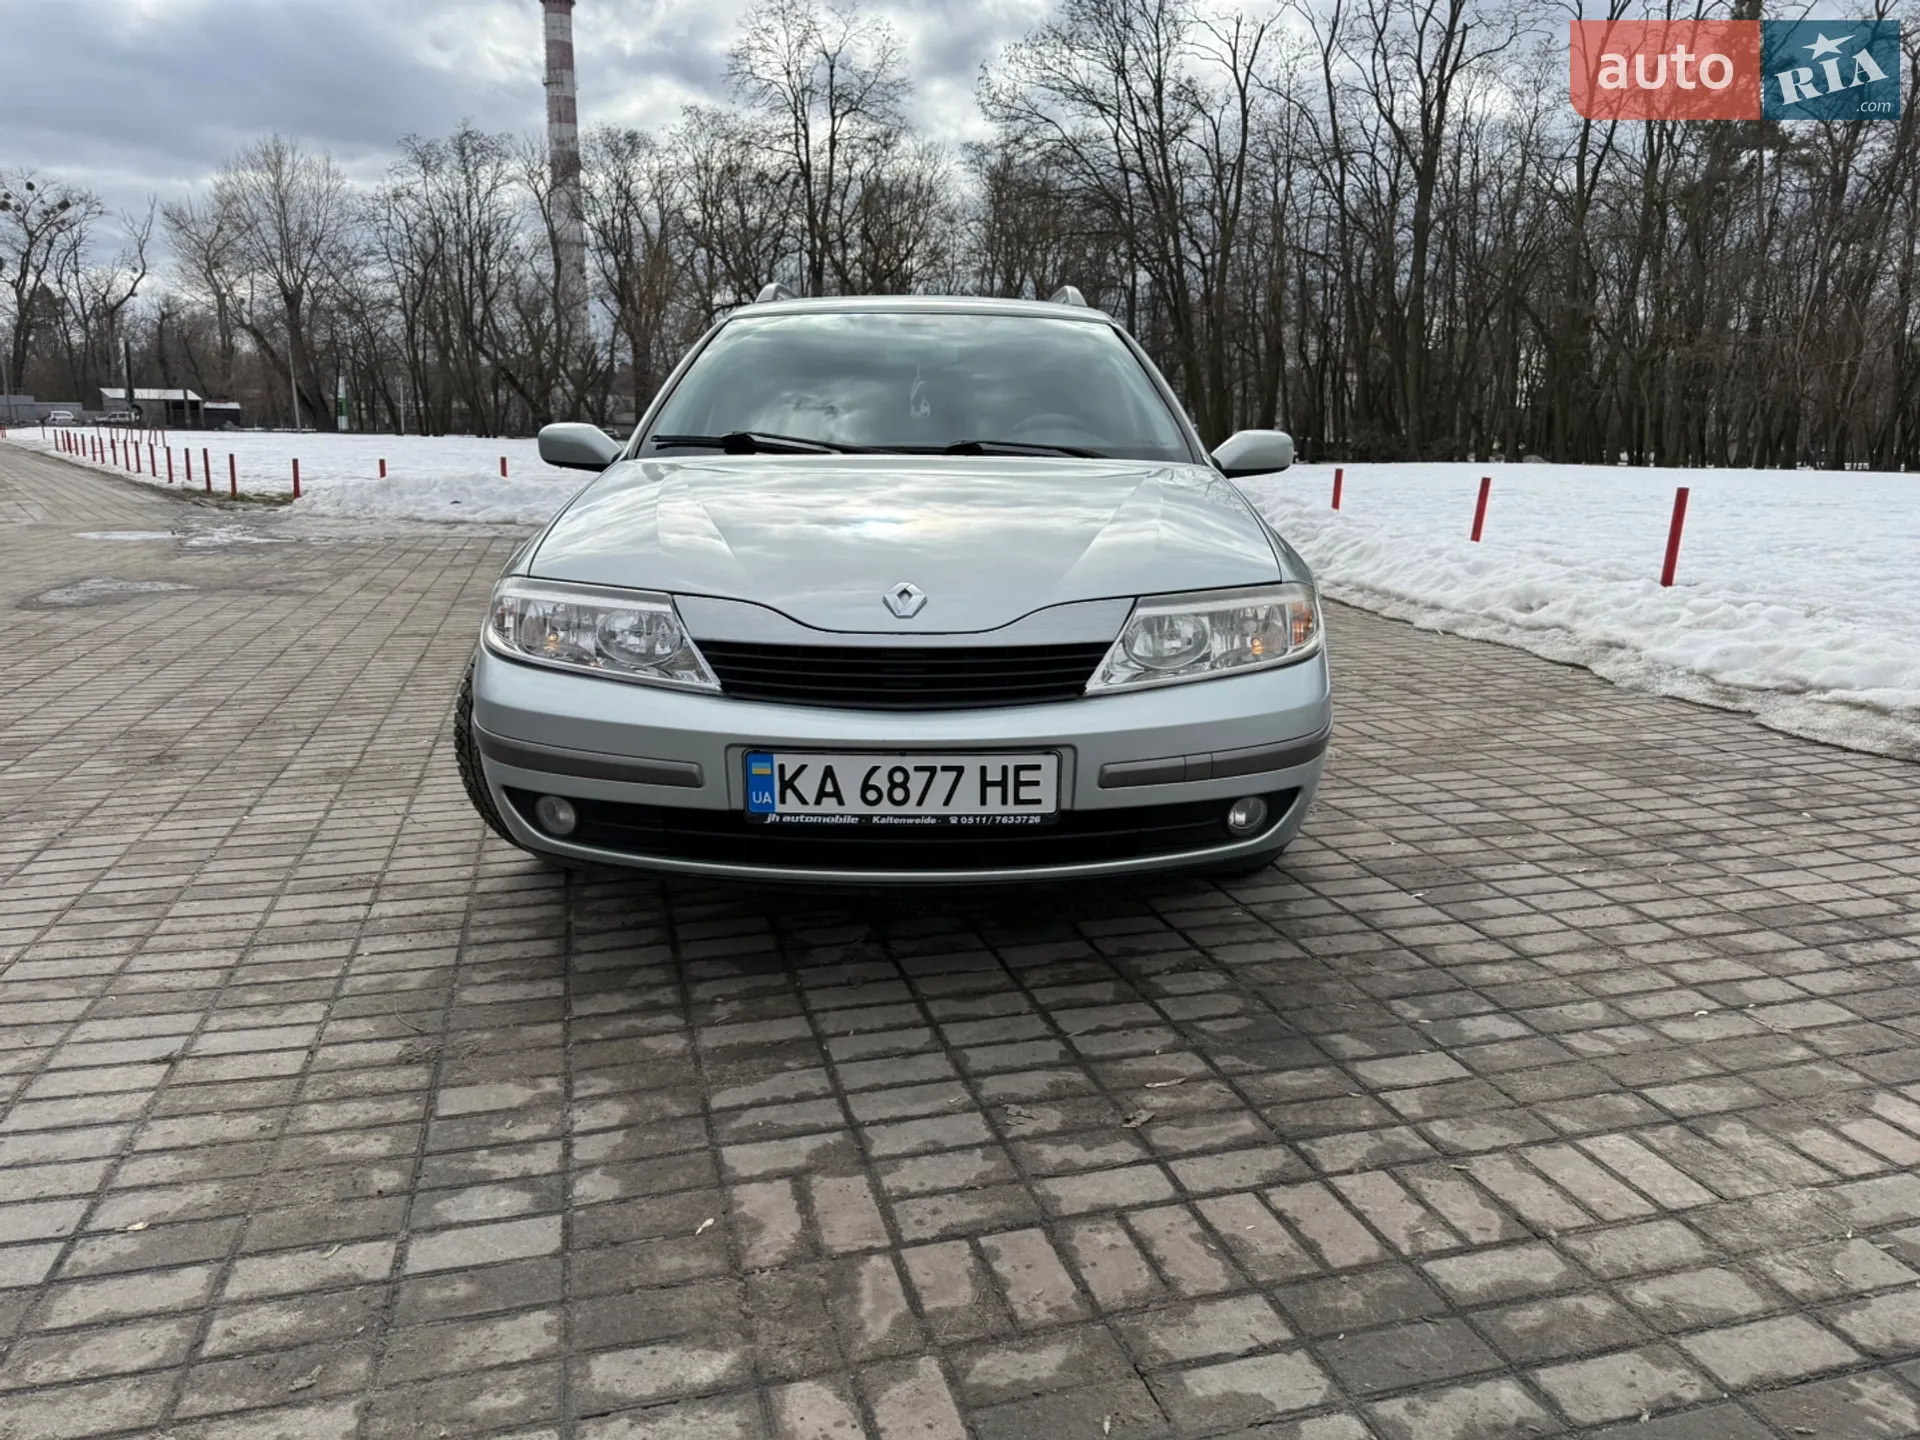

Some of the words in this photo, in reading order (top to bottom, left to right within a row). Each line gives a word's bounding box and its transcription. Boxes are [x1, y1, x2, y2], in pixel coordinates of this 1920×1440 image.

[778, 763, 845, 806] KA
[860, 765, 965, 806] 6877
[980, 764, 1042, 806] HE
[753, 791, 772, 804] UA
[782, 814, 859, 824] automobile
[872, 815, 937, 824] Kaltenweide
